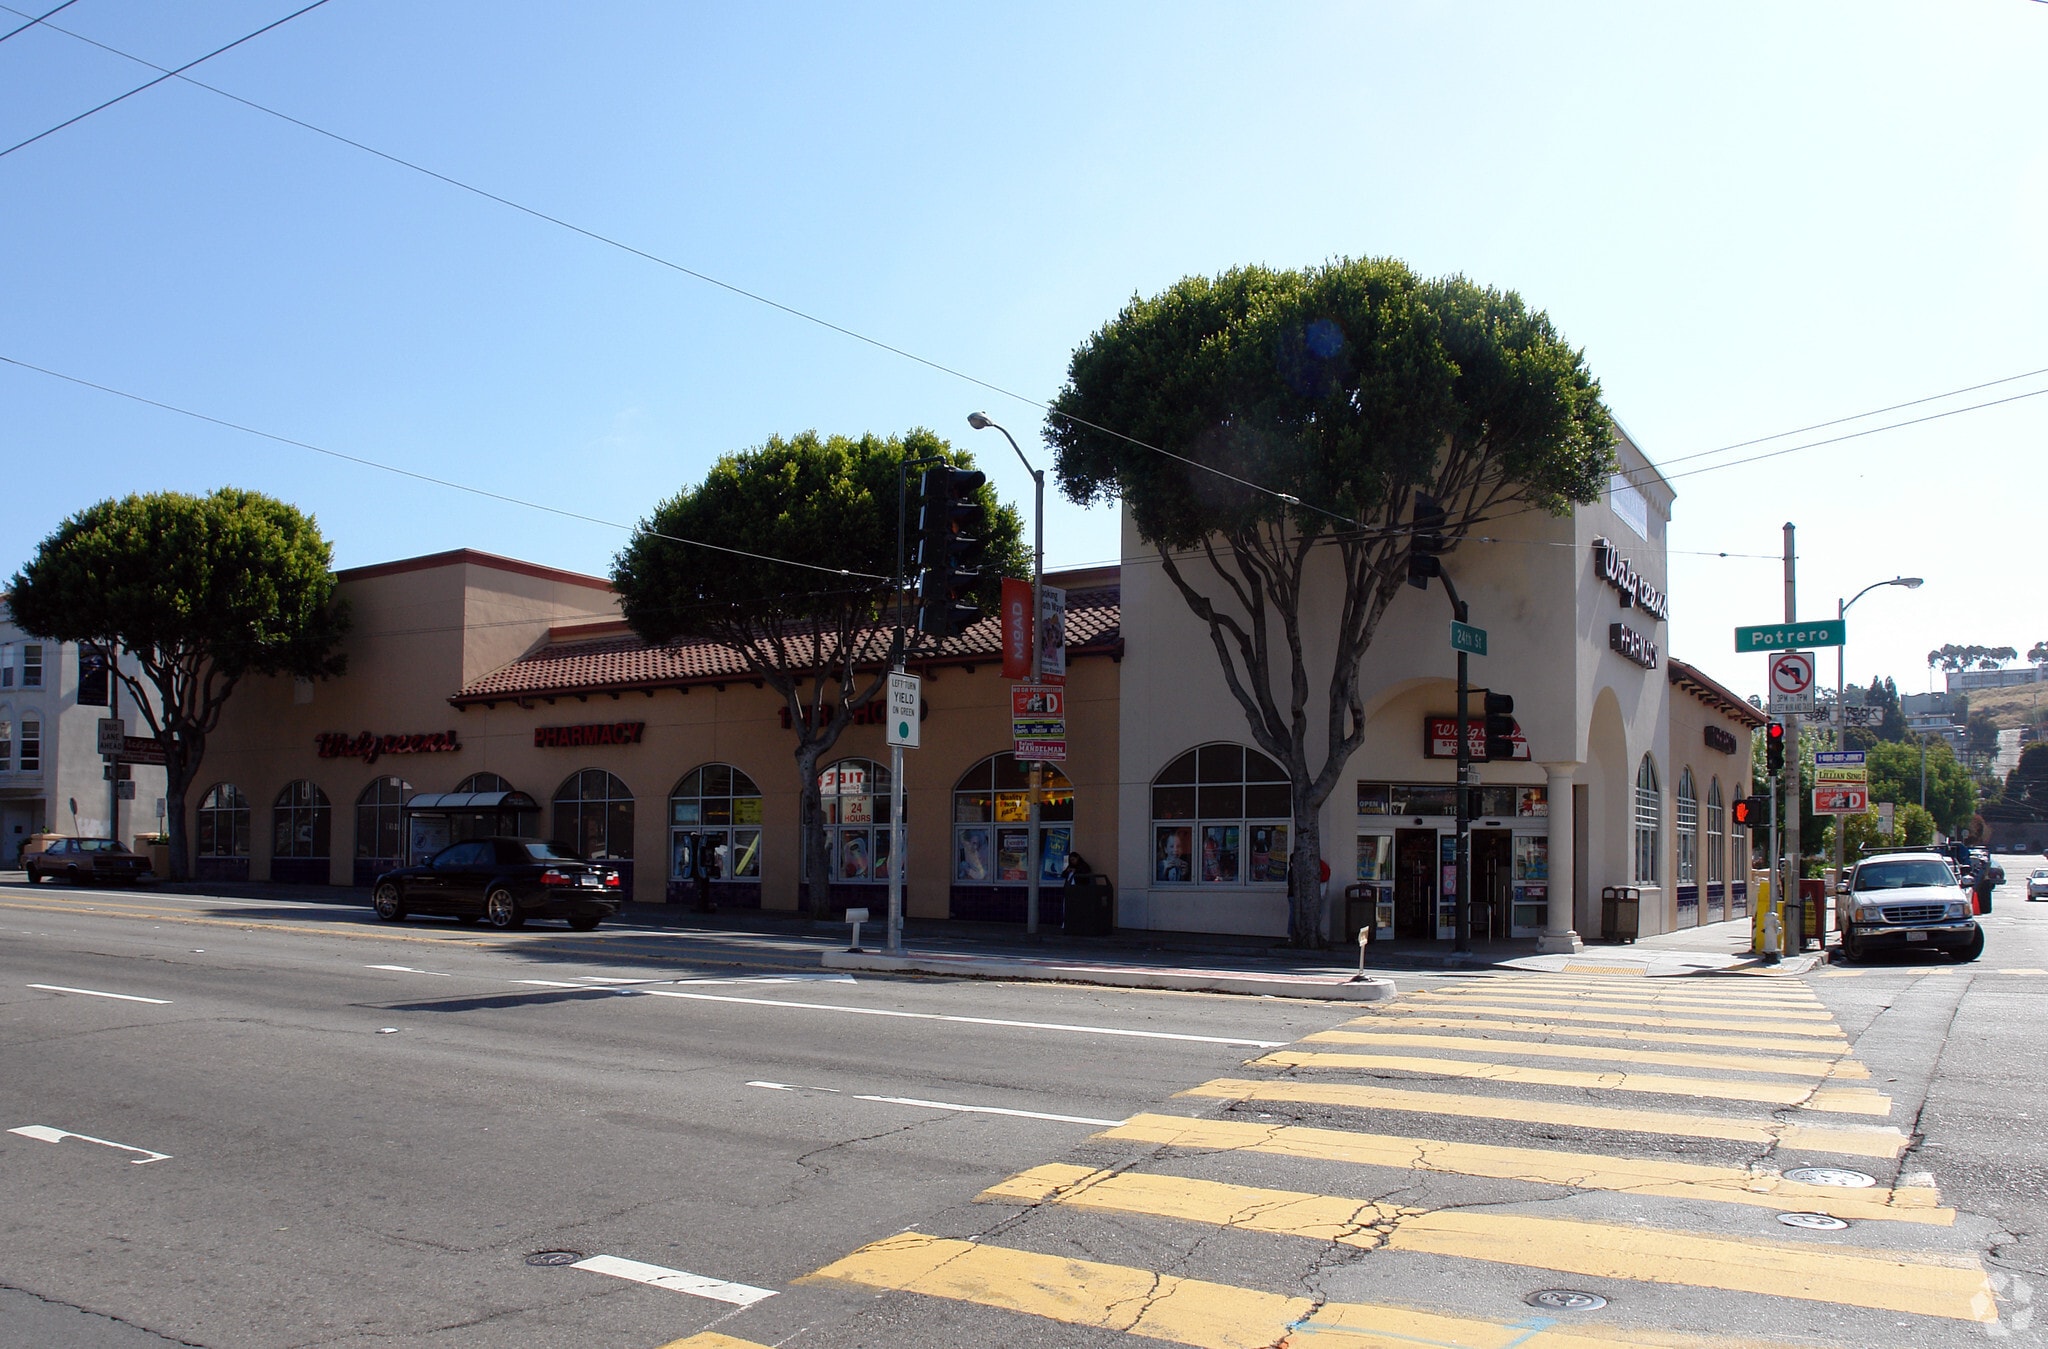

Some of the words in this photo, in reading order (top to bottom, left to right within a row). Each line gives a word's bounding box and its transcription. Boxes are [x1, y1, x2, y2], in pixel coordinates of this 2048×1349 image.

[1602, 536, 1668, 620] Walgreens
[1457, 629, 1472, 646] 24th
[1474, 633, 1482, 648] St
[1752, 630, 1829, 645] Potrero
[1620, 623, 1658, 669] PHARMACY
[891, 679, 903, 688] LEFT
[894, 692, 914, 704] YIELD
[1047, 693, 1058, 712] D
[892, 705, 899, 714] ON
[900, 707, 915, 716] GREEN
[104, 723, 118, 731] BUS
[102, 733, 120, 741] LANE
[534, 722, 645, 747] PHARMACY
[314, 731, 462, 763] Walgreens
[1019, 745, 1063, 753] MANDELMAN
[1819, 771, 1845, 779] LILLIAN
[1000, 793, 1022, 801] Quality
[1849, 793, 1861, 807] D
[851, 803, 862, 813] 24
[845, 815, 870, 823] HOURS
